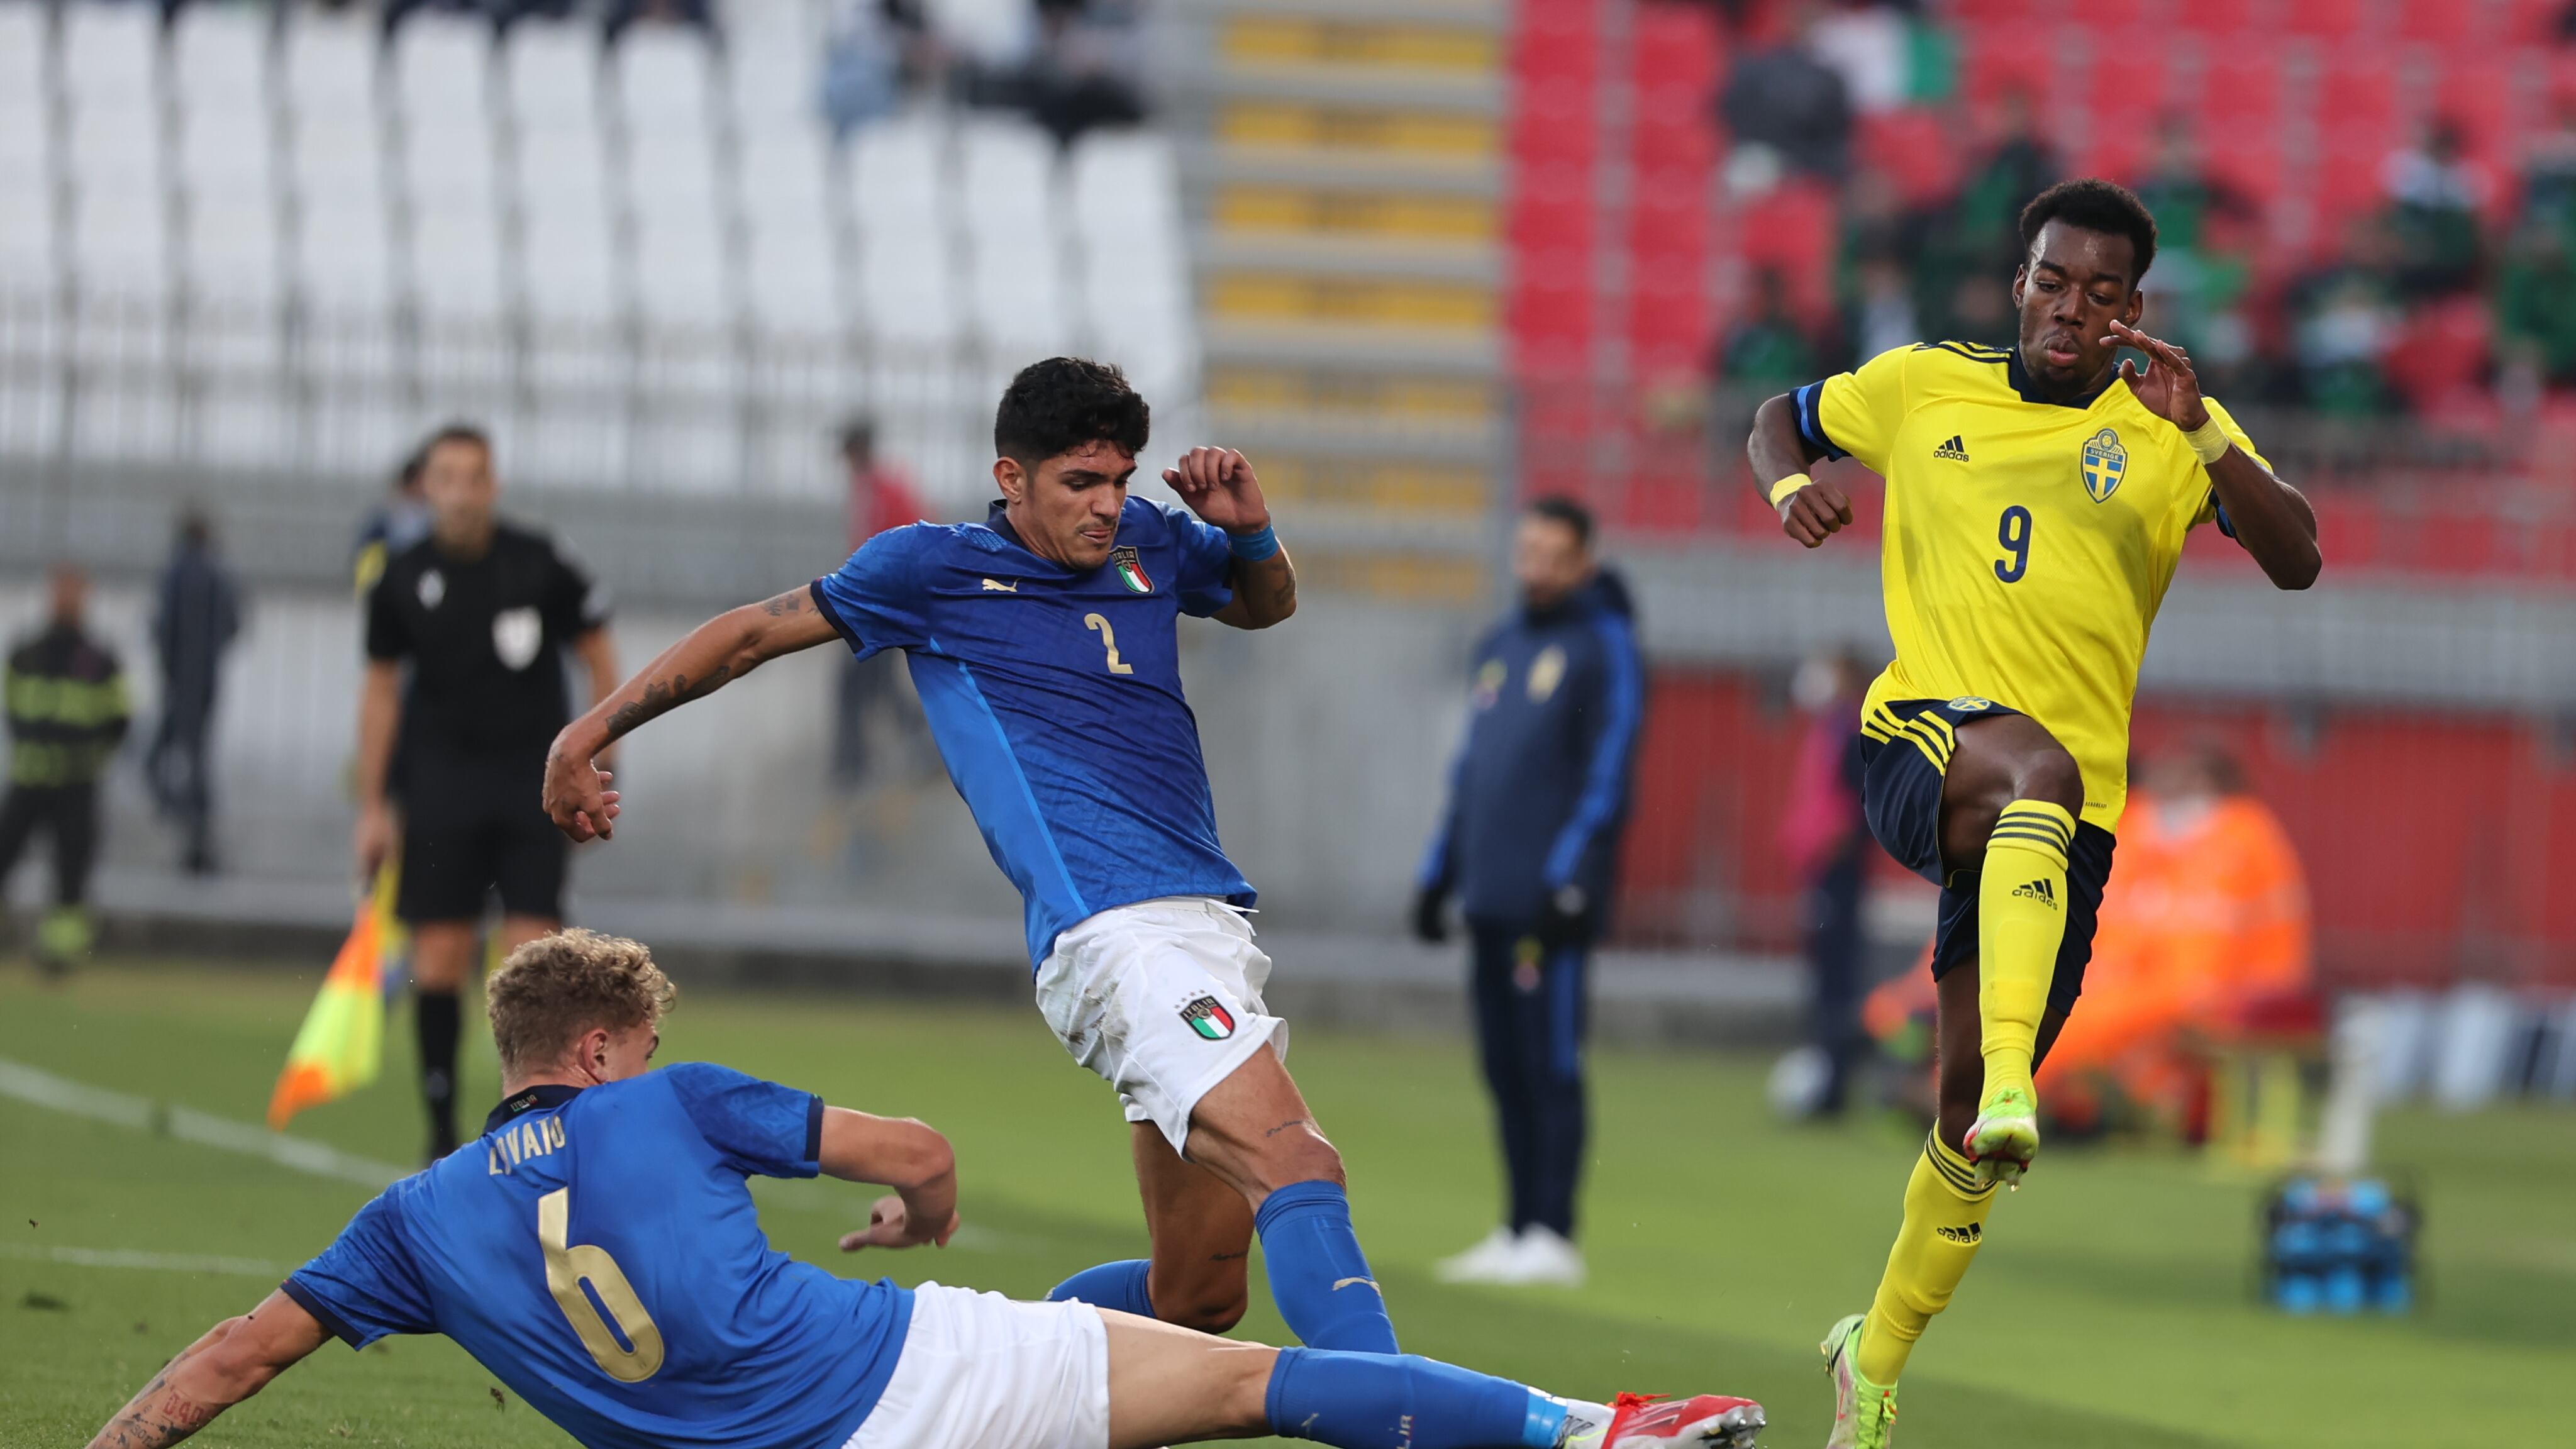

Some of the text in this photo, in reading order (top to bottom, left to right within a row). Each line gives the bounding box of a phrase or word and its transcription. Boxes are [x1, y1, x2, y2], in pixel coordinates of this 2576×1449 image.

[1933, 448, 1969, 462] adidas
[2090, 448, 2119, 460] SVERIGE
[1994, 505, 2032, 583] 9
[1112, 550, 1135, 562] ITALIA
[1084, 613, 1134, 674] 2
[2012, 889, 2057, 911] adidas
[510, 1094, 538, 1111] ITALIA
[1937, 1227, 1982, 1243] adida
[538, 1186, 664, 1382] 6
